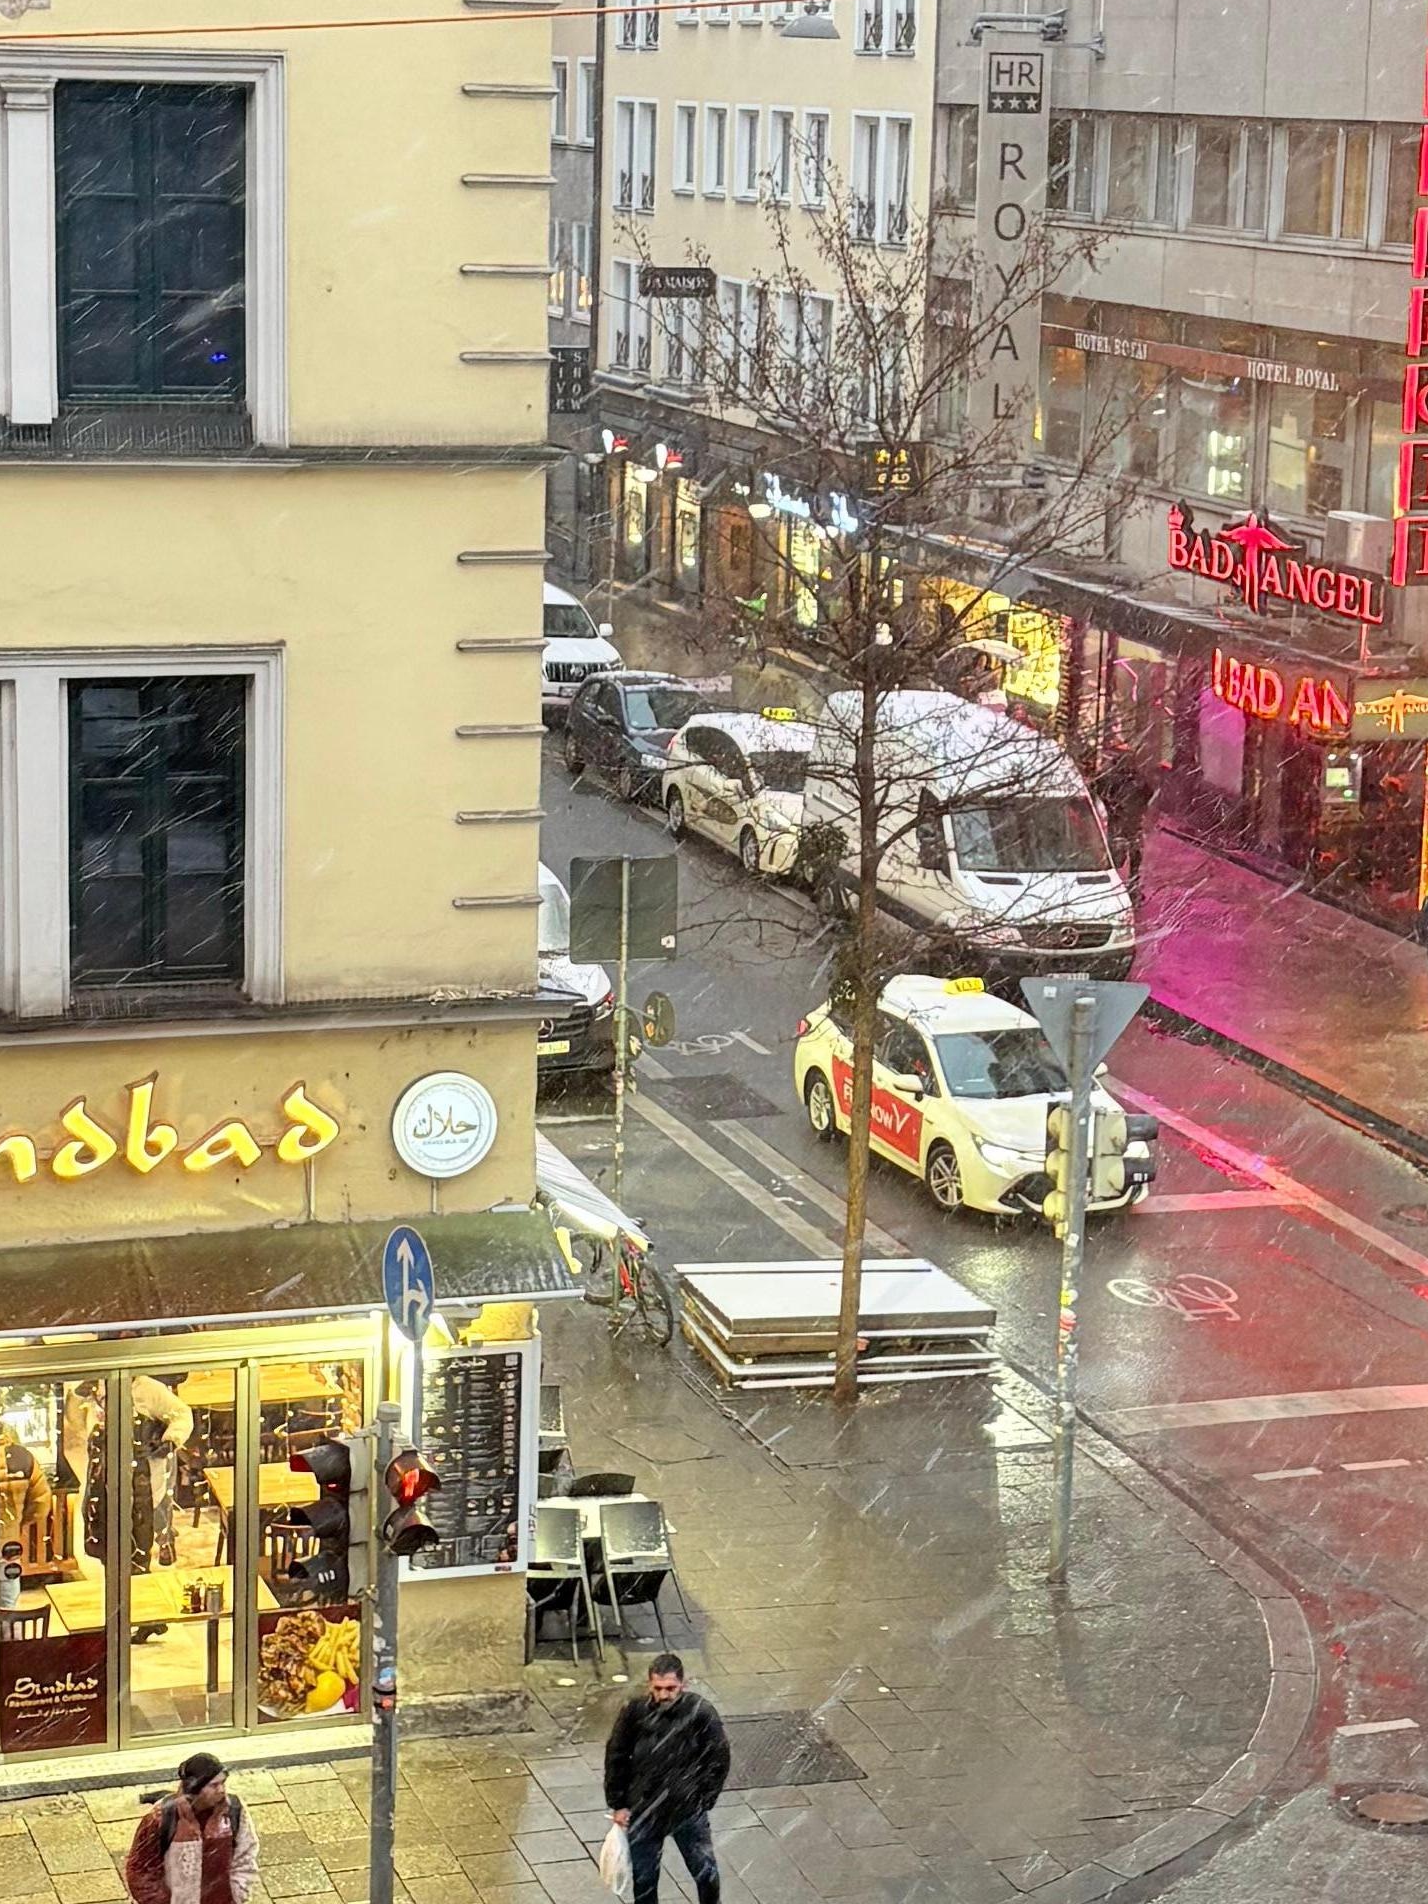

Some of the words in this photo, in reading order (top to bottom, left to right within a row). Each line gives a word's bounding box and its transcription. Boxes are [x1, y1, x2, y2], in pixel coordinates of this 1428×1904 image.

[995, 60, 1036, 87] HR
[989, 142, 1027, 420] ROYAL
[1074, 332, 1112, 354] HOTEL
[1247, 359, 1291, 384] HOTEL
[1295, 366, 1340, 392] ROYAL
[1169, 528, 1234, 581] BAD
[1260, 555, 1385, 625] ANGEL
[4, 1672, 99, 1707] Sindbad
